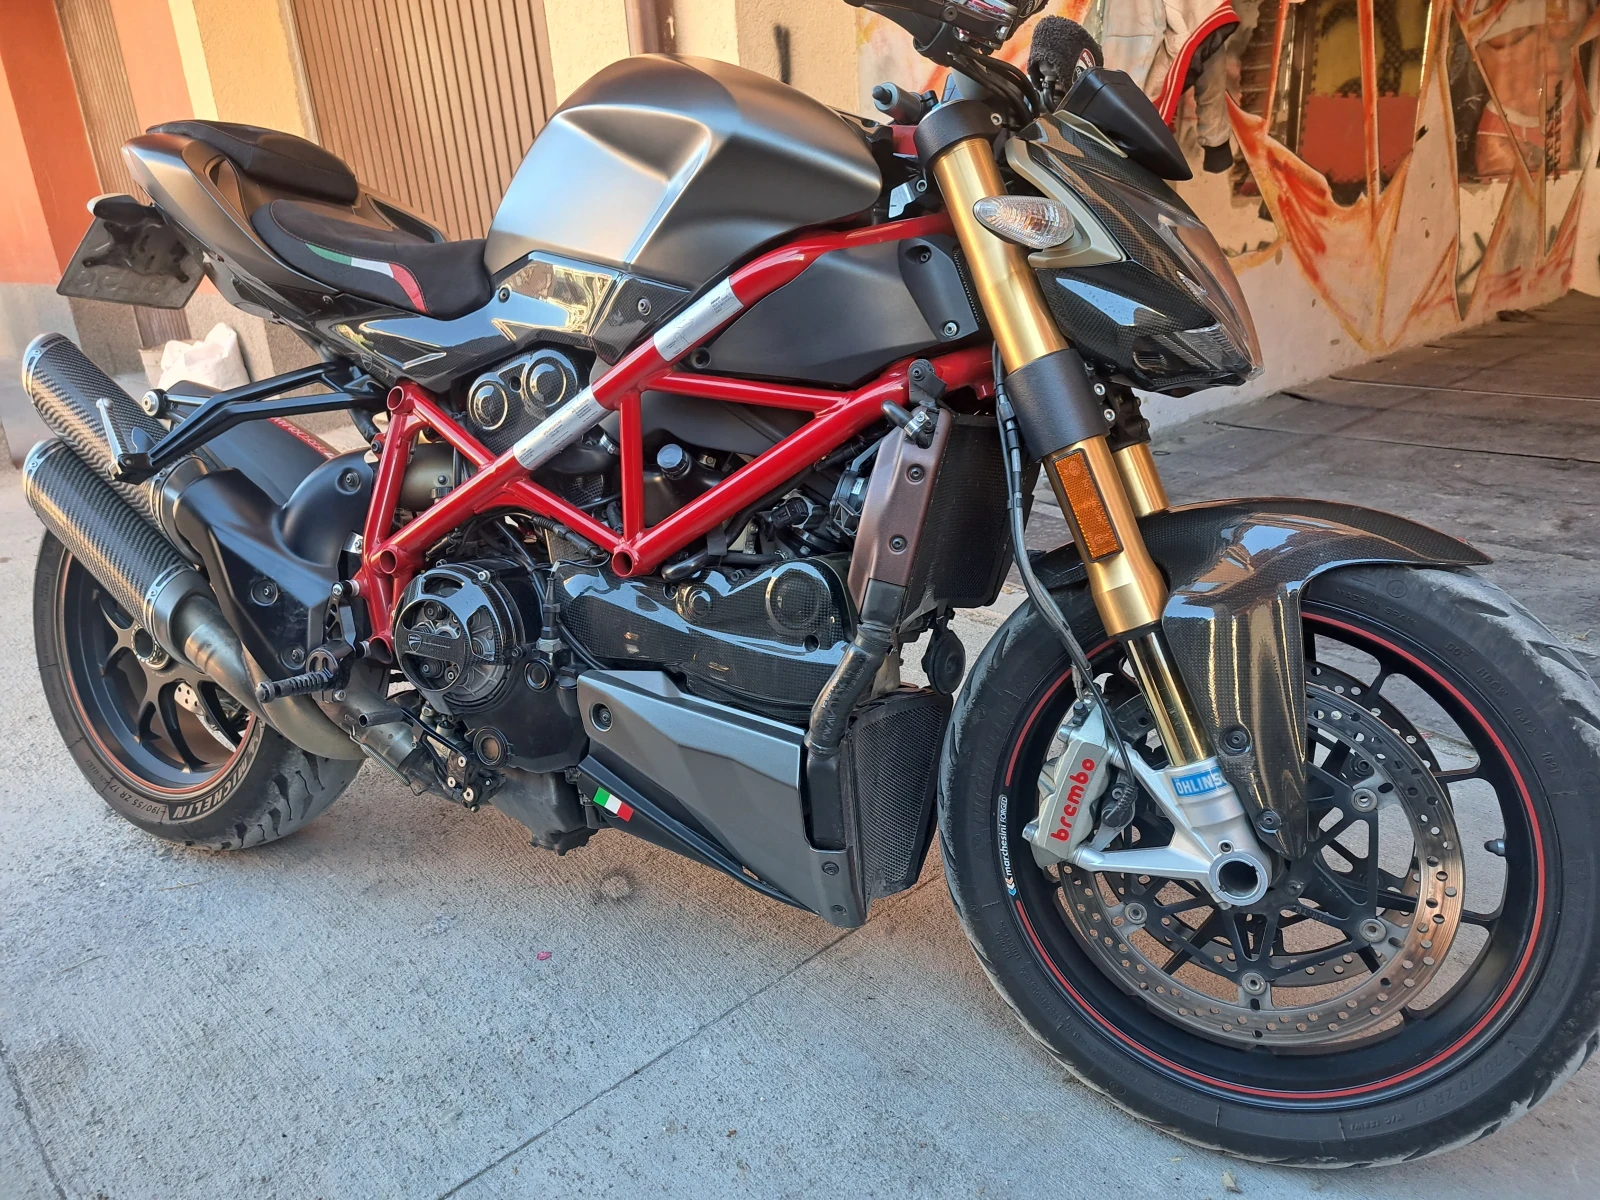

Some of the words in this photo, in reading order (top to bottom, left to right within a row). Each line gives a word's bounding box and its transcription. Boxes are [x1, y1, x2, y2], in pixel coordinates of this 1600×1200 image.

[1336, 588, 1367, 605] MADE
[1384, 606, 1418, 627] SPAIN
[108, 782, 119, 791] 17
[119, 791, 131, 802] ZR
[172, 759, 248, 819] MICHELIN
[1050, 758, 1096, 842] brembo
[132, 799, 161, 815] 190/55
[1000, 795, 1008, 822] FORGED
[1000, 823, 1012, 876] marchesini
[1459, 1053, 1510, 1093] 120/70
[1433, 1087, 1455, 1106] ZR
